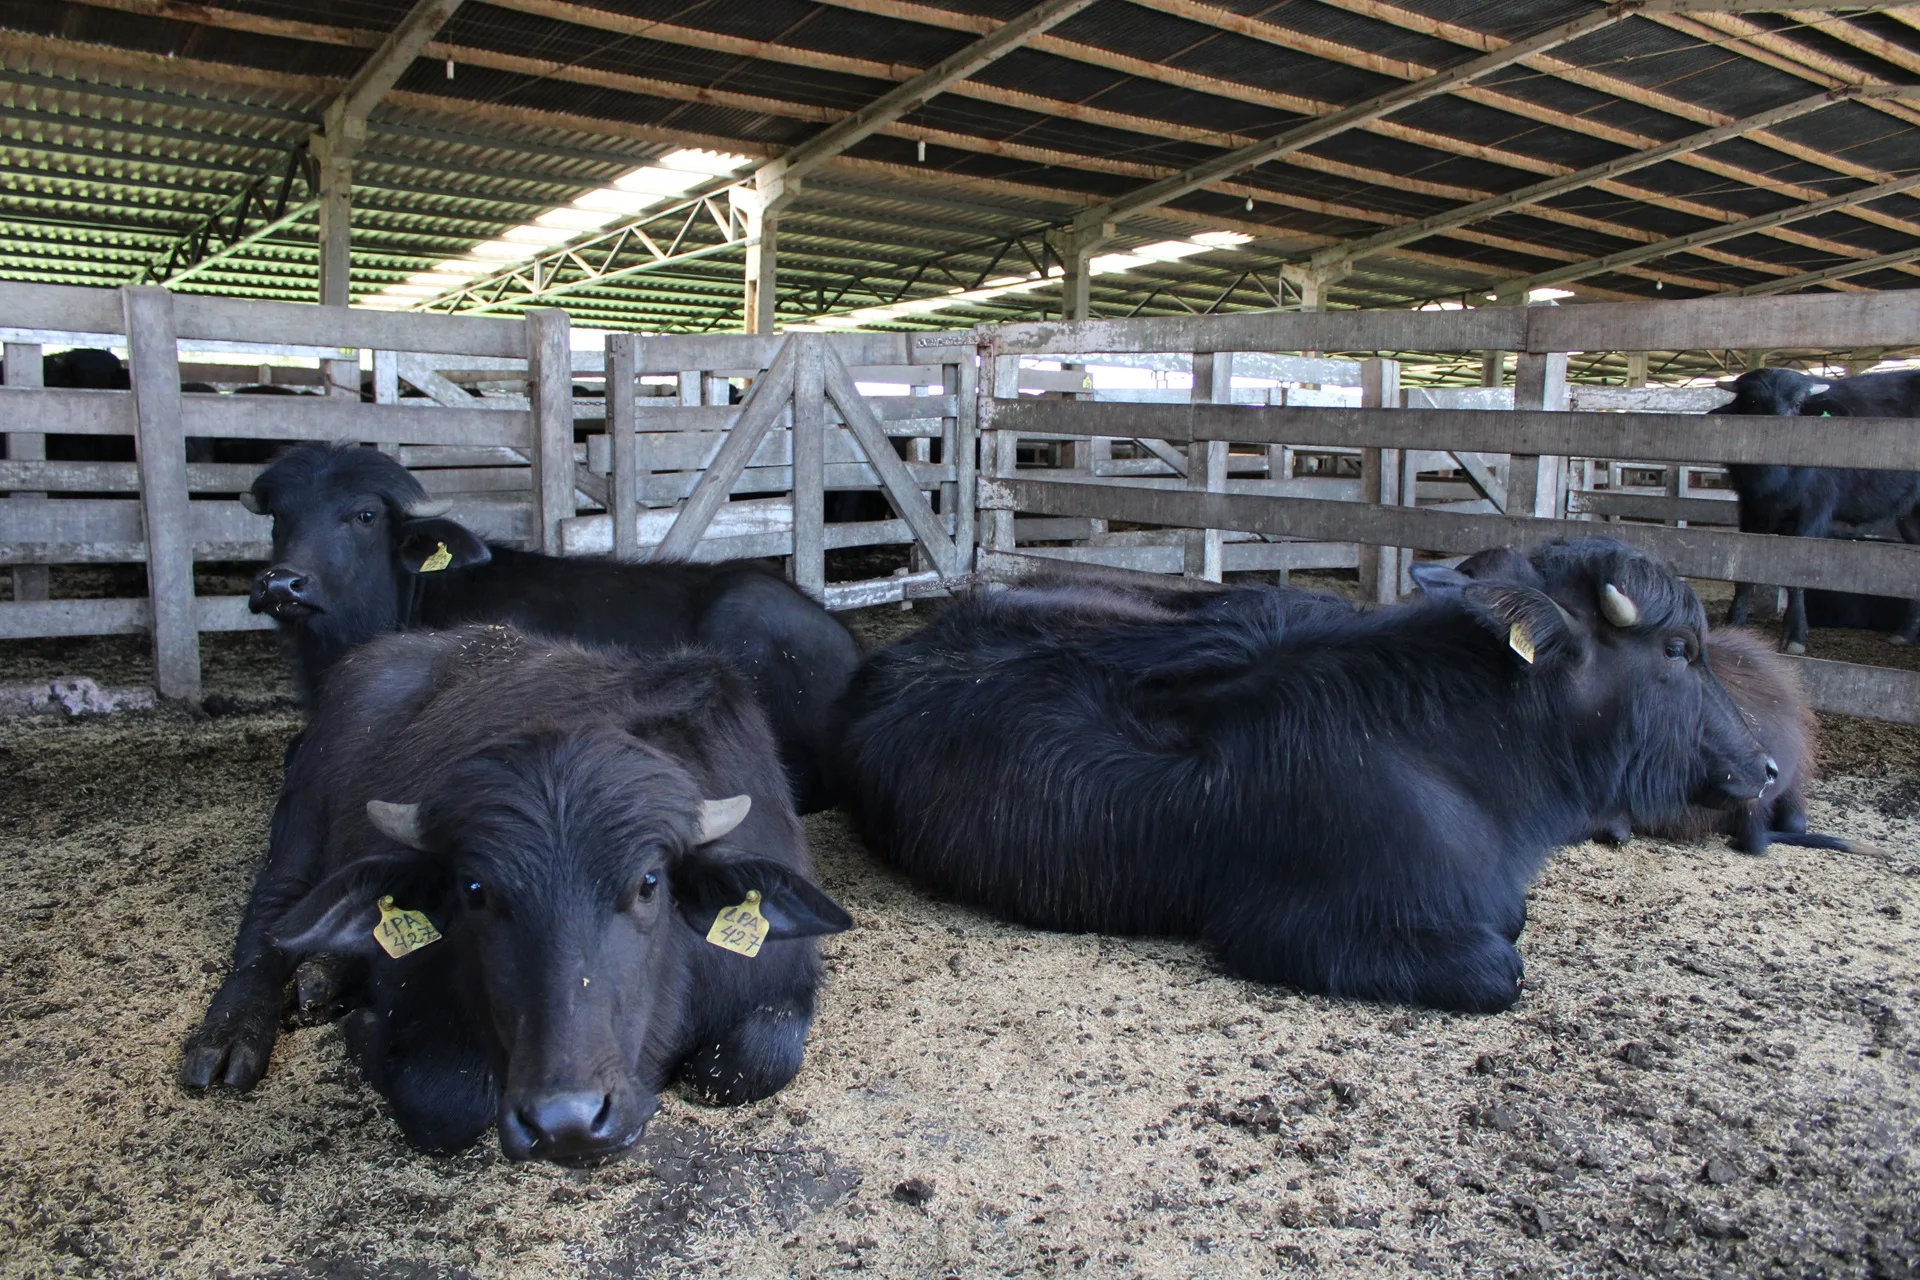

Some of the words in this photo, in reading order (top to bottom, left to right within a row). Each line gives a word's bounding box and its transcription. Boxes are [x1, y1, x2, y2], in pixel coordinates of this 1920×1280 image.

[382, 913, 421, 937] LPA
[723, 908, 758, 932] LPA
[394, 926, 434, 948] 427
[720, 925, 760, 952] 427
